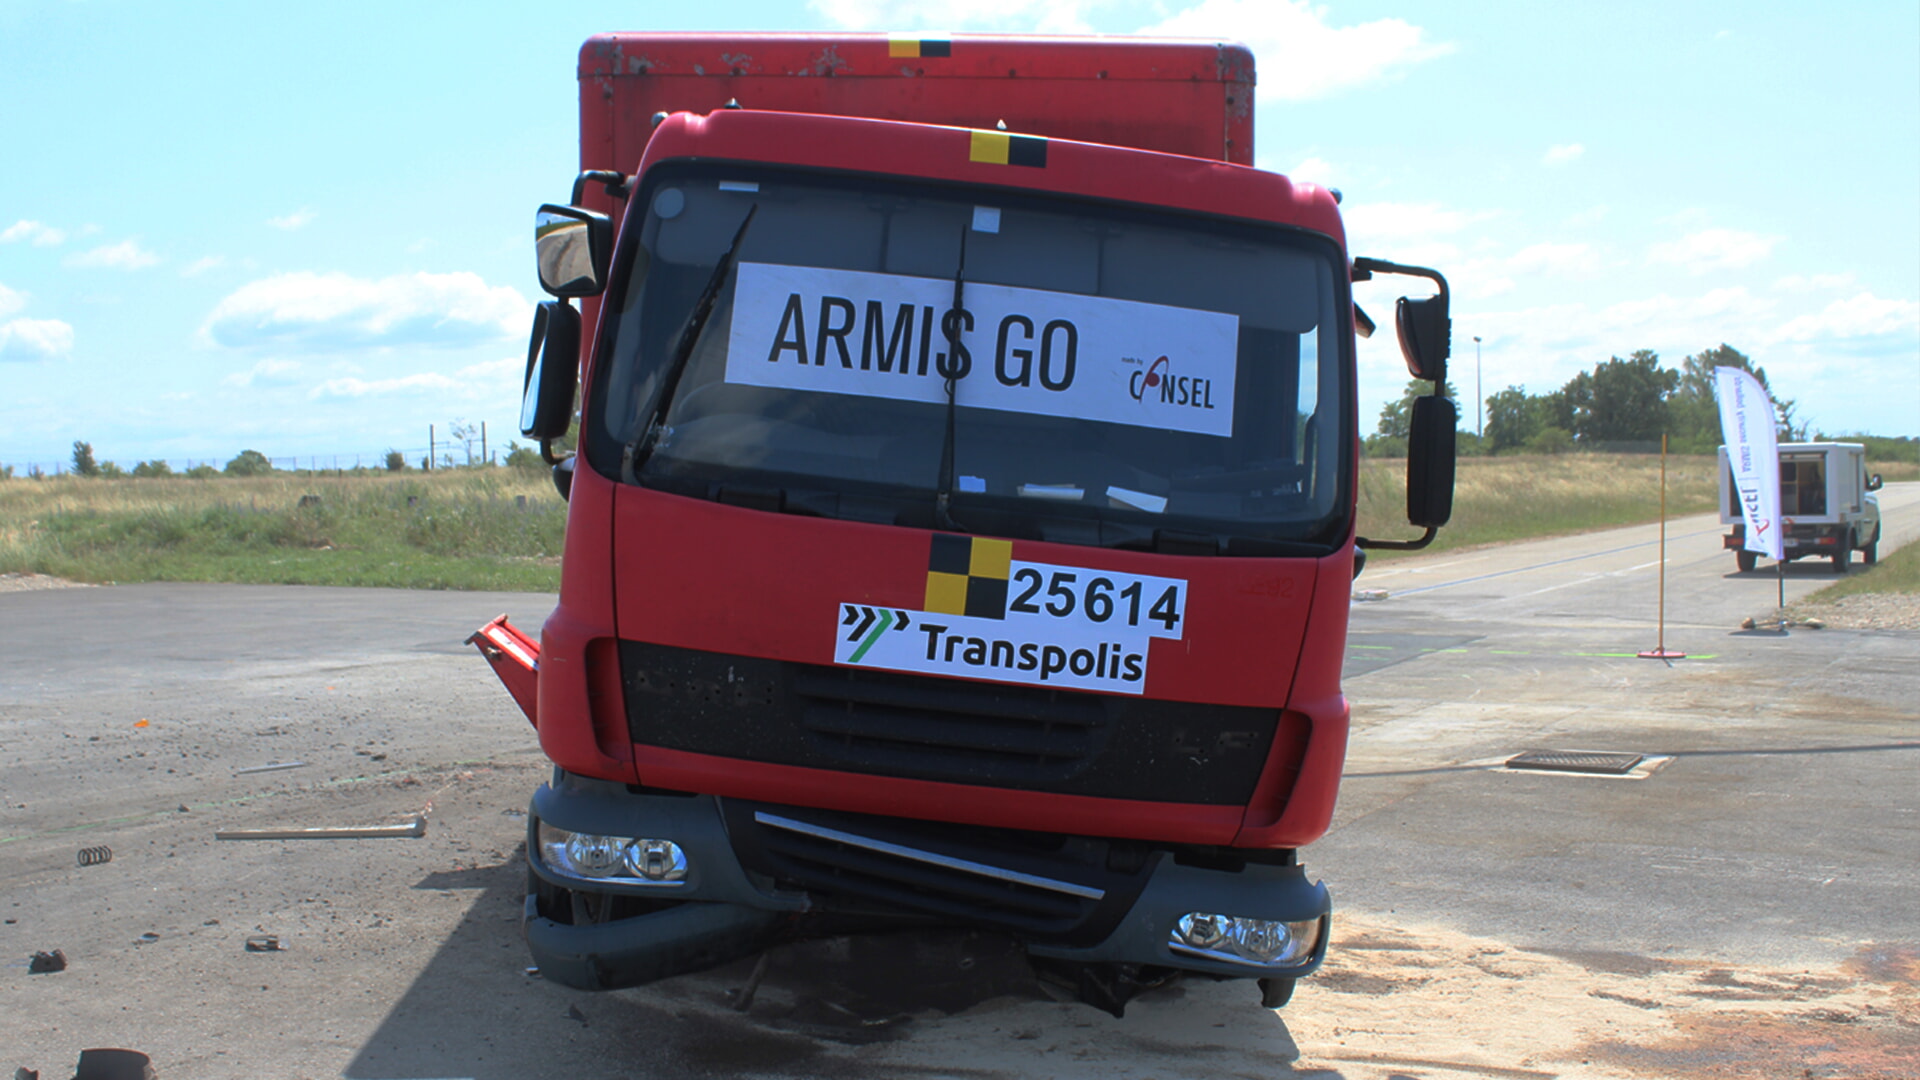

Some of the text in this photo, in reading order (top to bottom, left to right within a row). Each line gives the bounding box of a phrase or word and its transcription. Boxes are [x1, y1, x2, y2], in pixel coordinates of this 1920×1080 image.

[767, 292, 1079, 392] ARMIS GO
[1137, 357, 1144, 366] by
[1008, 567, 1181, 631] 25614
[918, 623, 1143, 682] Transpolis
